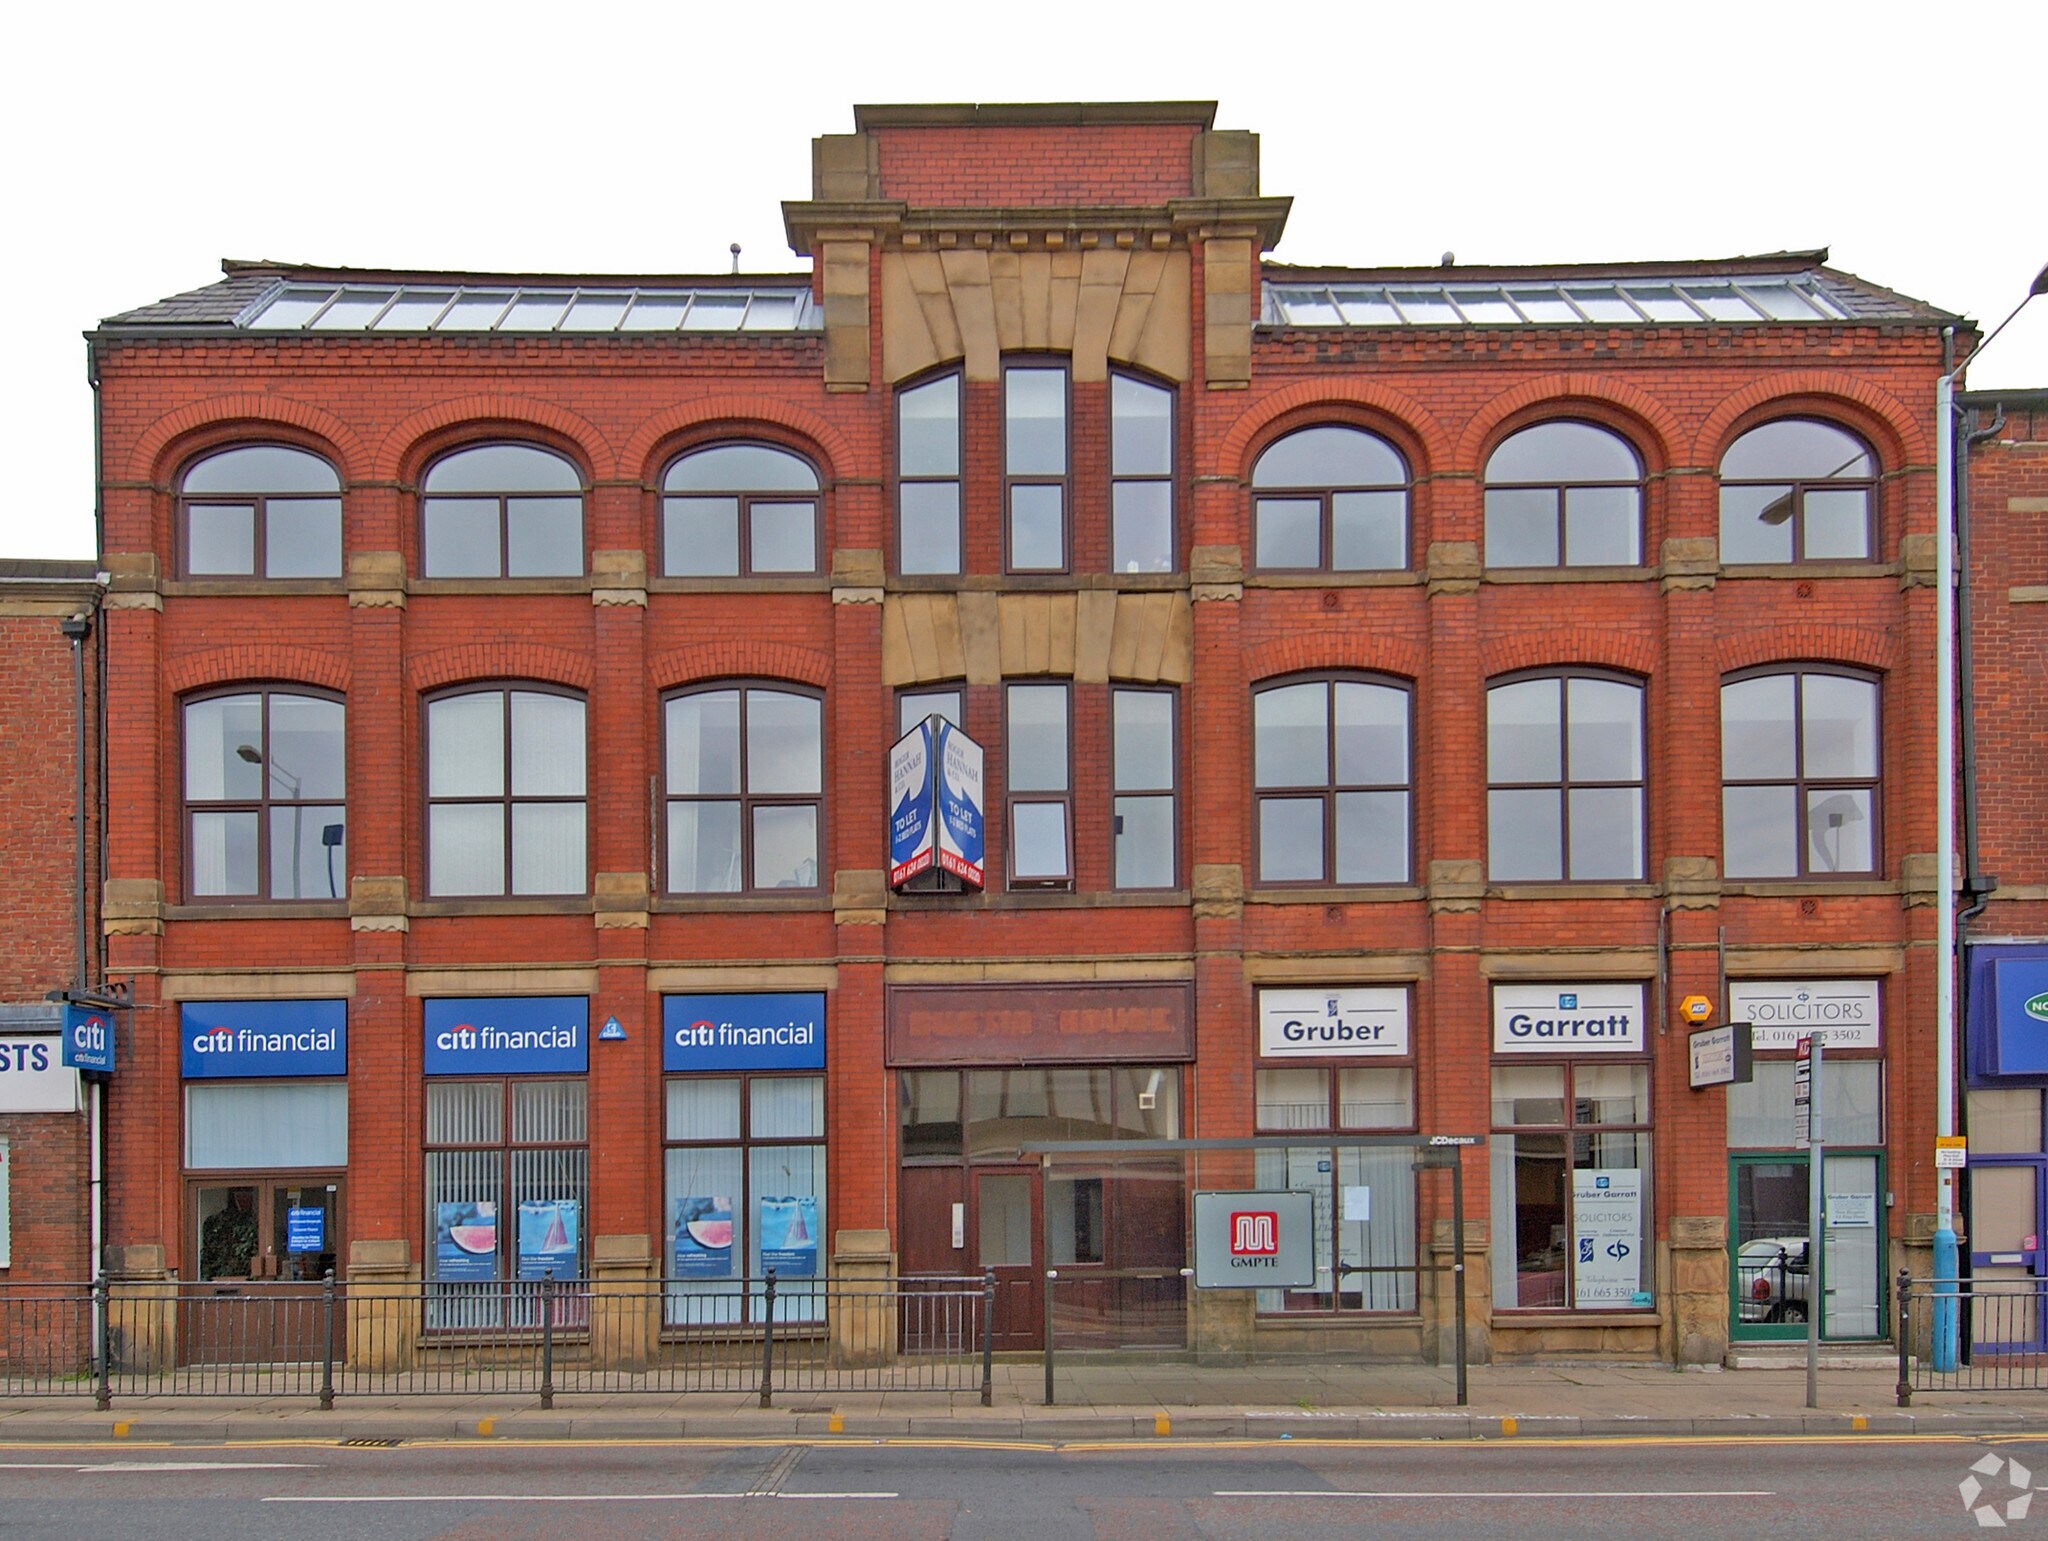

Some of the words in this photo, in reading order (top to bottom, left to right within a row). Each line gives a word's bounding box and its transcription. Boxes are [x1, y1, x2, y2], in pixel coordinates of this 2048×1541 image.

[895, 752, 922, 783] HANNAH
[947, 752, 978, 783] HANNAH
[895, 817, 905, 832] TO
[906, 808, 917, 826] LET
[949, 800, 960, 816] TO
[960, 808, 972, 824] LET
[1747, 1003, 1863, 1021] SOLICITORS
[75, 1018, 105, 1051] citi
[675, 1022, 714, 1046] citi
[718, 1022, 813, 1046] financial
[1283, 1019, 1384, 1041] Gruber
[1509, 1014, 1629, 1037] Garratt
[1831, 1030, 1861, 1041] 3502
[193, 1028, 233, 1053] citi
[237, 1028, 336, 1052] financial
[436, 1025, 476, 1050] citi
[480, 1025, 577, 1050] financial
[0, 1043, 48, 1071] STS
[1429, 1136, 1475, 1145] JCDecaux
[1572, 1190, 1600, 1199] ruber
[1604, 1190, 1638, 1199] Garratt
[1574, 1212, 1633, 1223] SOLICITORS
[1231, 1257, 1278, 1268] GMPTE
[1594, 1287, 1611, 1298] 665
